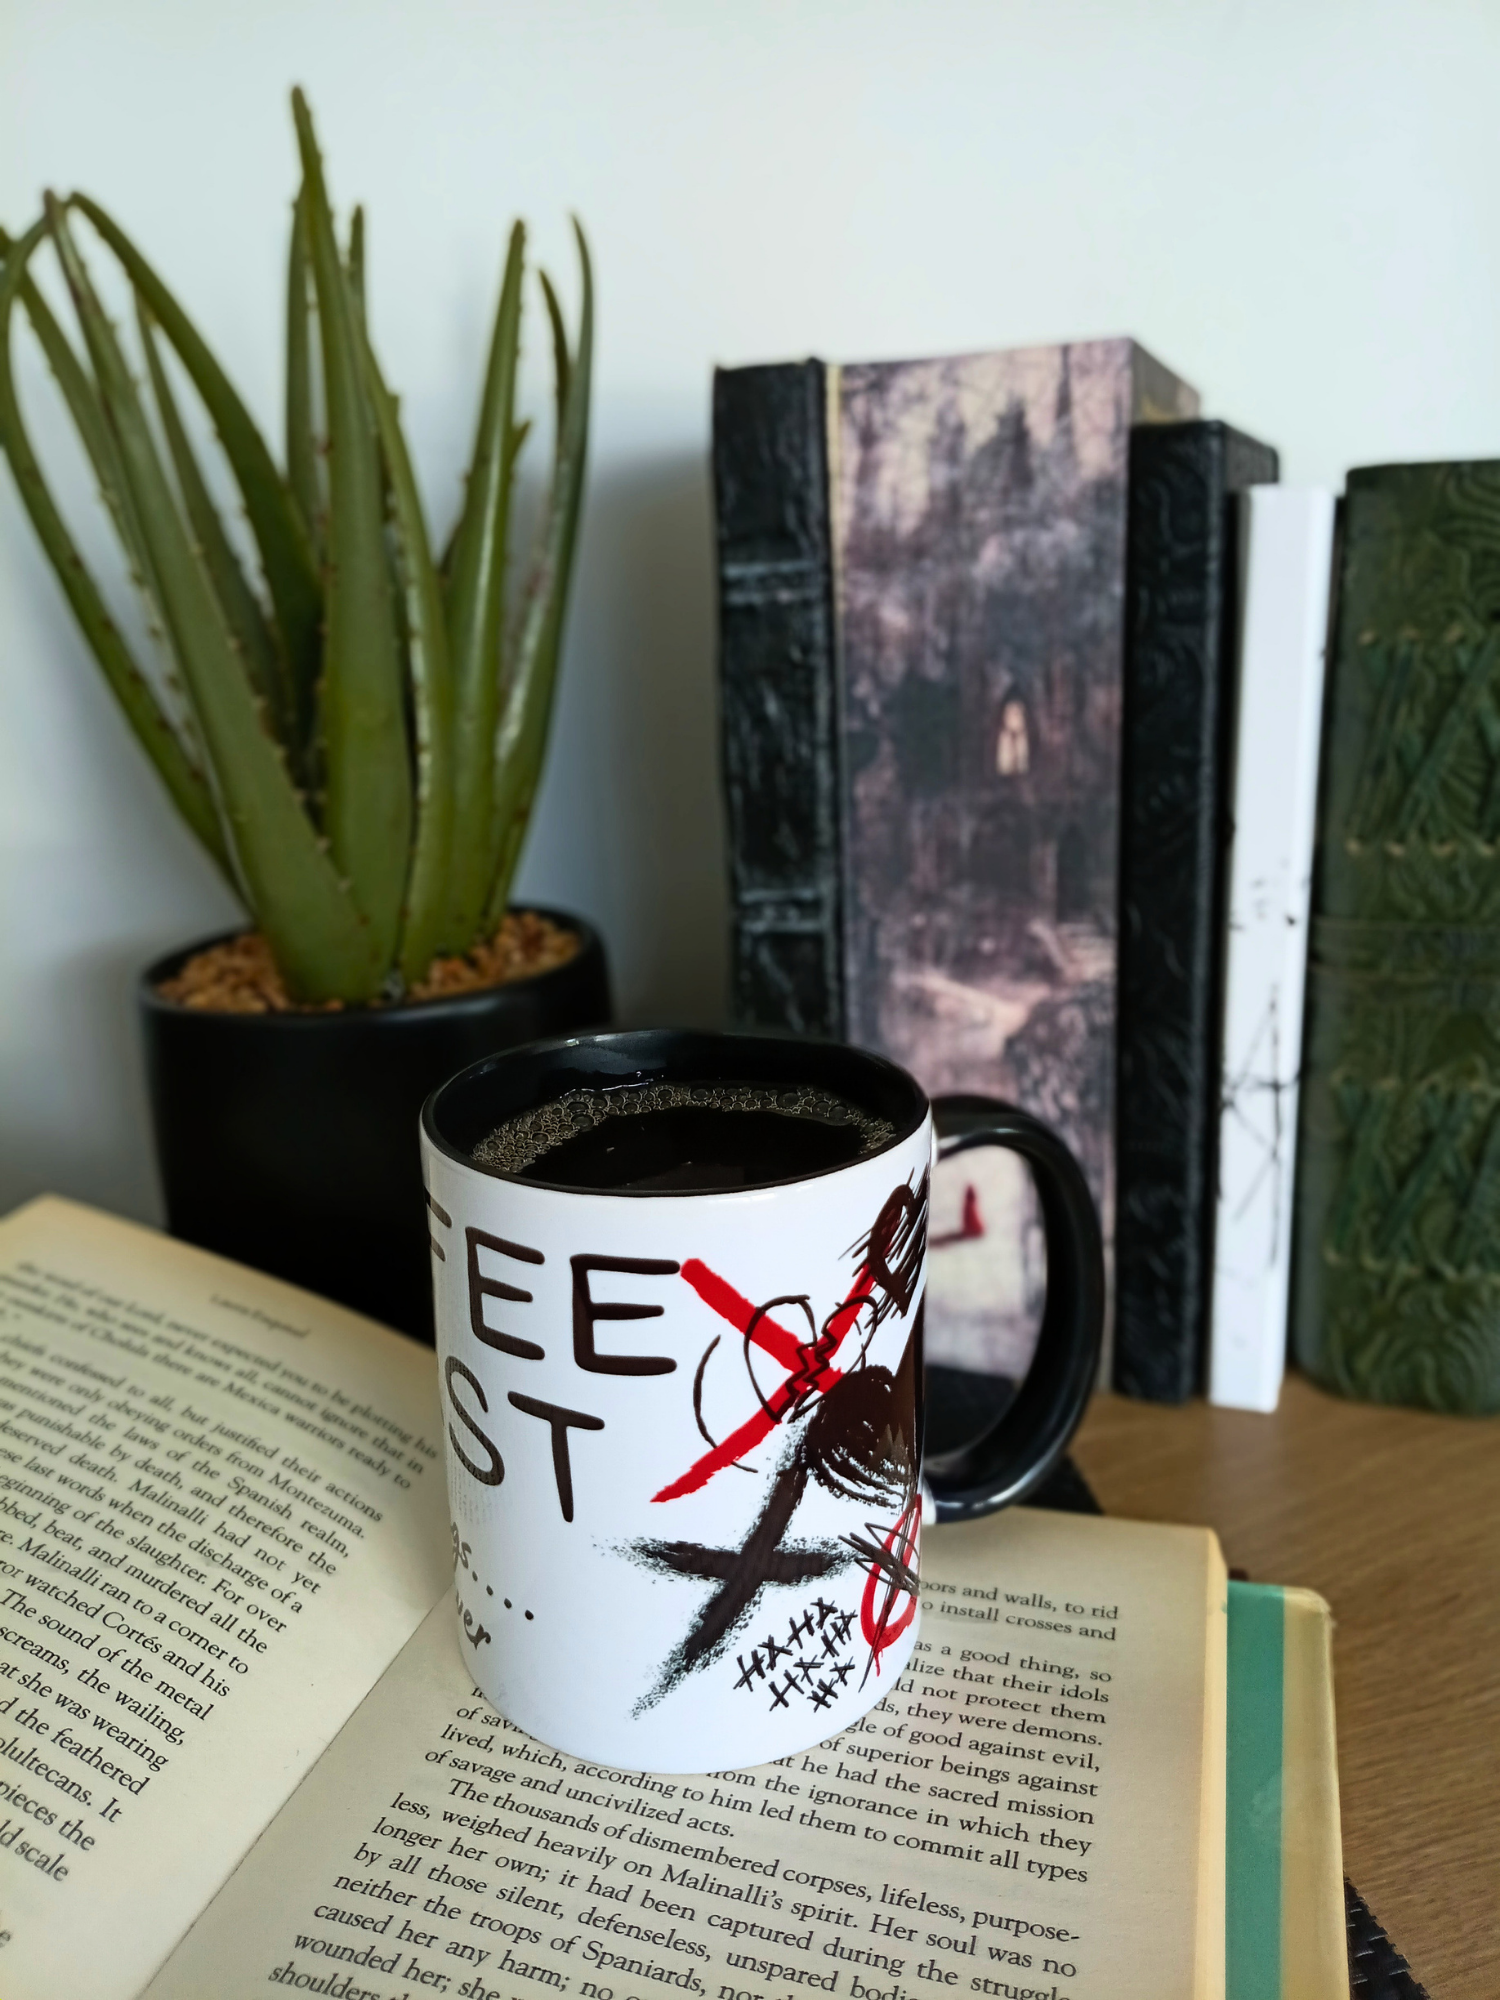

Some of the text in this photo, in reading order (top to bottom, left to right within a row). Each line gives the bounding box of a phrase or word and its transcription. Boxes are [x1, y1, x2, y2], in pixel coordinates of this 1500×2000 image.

[108, 1498, 302, 1614] when the discharge of a
[127, 1478, 321, 1594] Malinalli had not yet
[227, 1476, 348, 1558] Spanish realm,
[17, 1536, 248, 1674] Malinalli ran to a corner to
[42, 1519, 267, 1653] beat, and murdered all the
[72, 1510, 287, 1633] of the slaughter. For over
[962, 1587, 1118, 1620] and walls, to rid
[0, 1588, 214, 1721] The sound of the metal
[25, 1573, 230, 1696] watched Cortés and his
[940, 1600, 1116, 1641] install crosses and
[940, 1645, 1112, 1682] a good thing, so
[0, 1626, 185, 1745] screams, the wailing,
[16, 1671, 169, 1772] she was wearing
[907, 1702, 1102, 1745] they were demons.
[921, 1686, 1106, 1724] not protect them
[952, 1665, 1109, 1702] that their idols
[14, 1707, 150, 1795] the feathered
[800, 1755, 1094, 1824] he had the sacred mission
[819, 1736, 1098, 1797] of superior beings against
[882, 1723, 1099, 1772] of good against evil,
[58, 1819, 95, 1851] the
[98, 1796, 122, 1823] It
[424, 1749, 734, 1837] of savage and uncivilized acts.
[440, 1723, 1087, 1883] lived, which, according to him led them to commit all types
[764, 1775, 1092, 1856] the ignorance in which they
[14, 1841, 68, 1881] scale
[371, 1816, 958, 1985] longer her own; it had been captured during the
[389, 1791, 430, 1819] less,
[442, 1810, 532, 1843] weighed
[533, 1830, 617, 1870] heavily
[623, 1860, 652, 1878] on
[790, 1902, 857, 1928] spirit.
[868, 1913, 918, 1942] Her
[925, 1933, 976, 1956] soul
[987, 1946, 1032, 1968] was
[1042, 1958, 1076, 1977] no
[448, 1778, 1079, 1942] The thousands of dismembered corpses, lifeless, purpose-
[313, 1905, 613, 2000] caused her any harm; no
[332, 1876, 705, 1997] neither the troops of Spaniards,
[353, 1842, 839, 1992] by all those silent, defenseless, unspared
[294, 1934, 451, 1993] wounded her;
